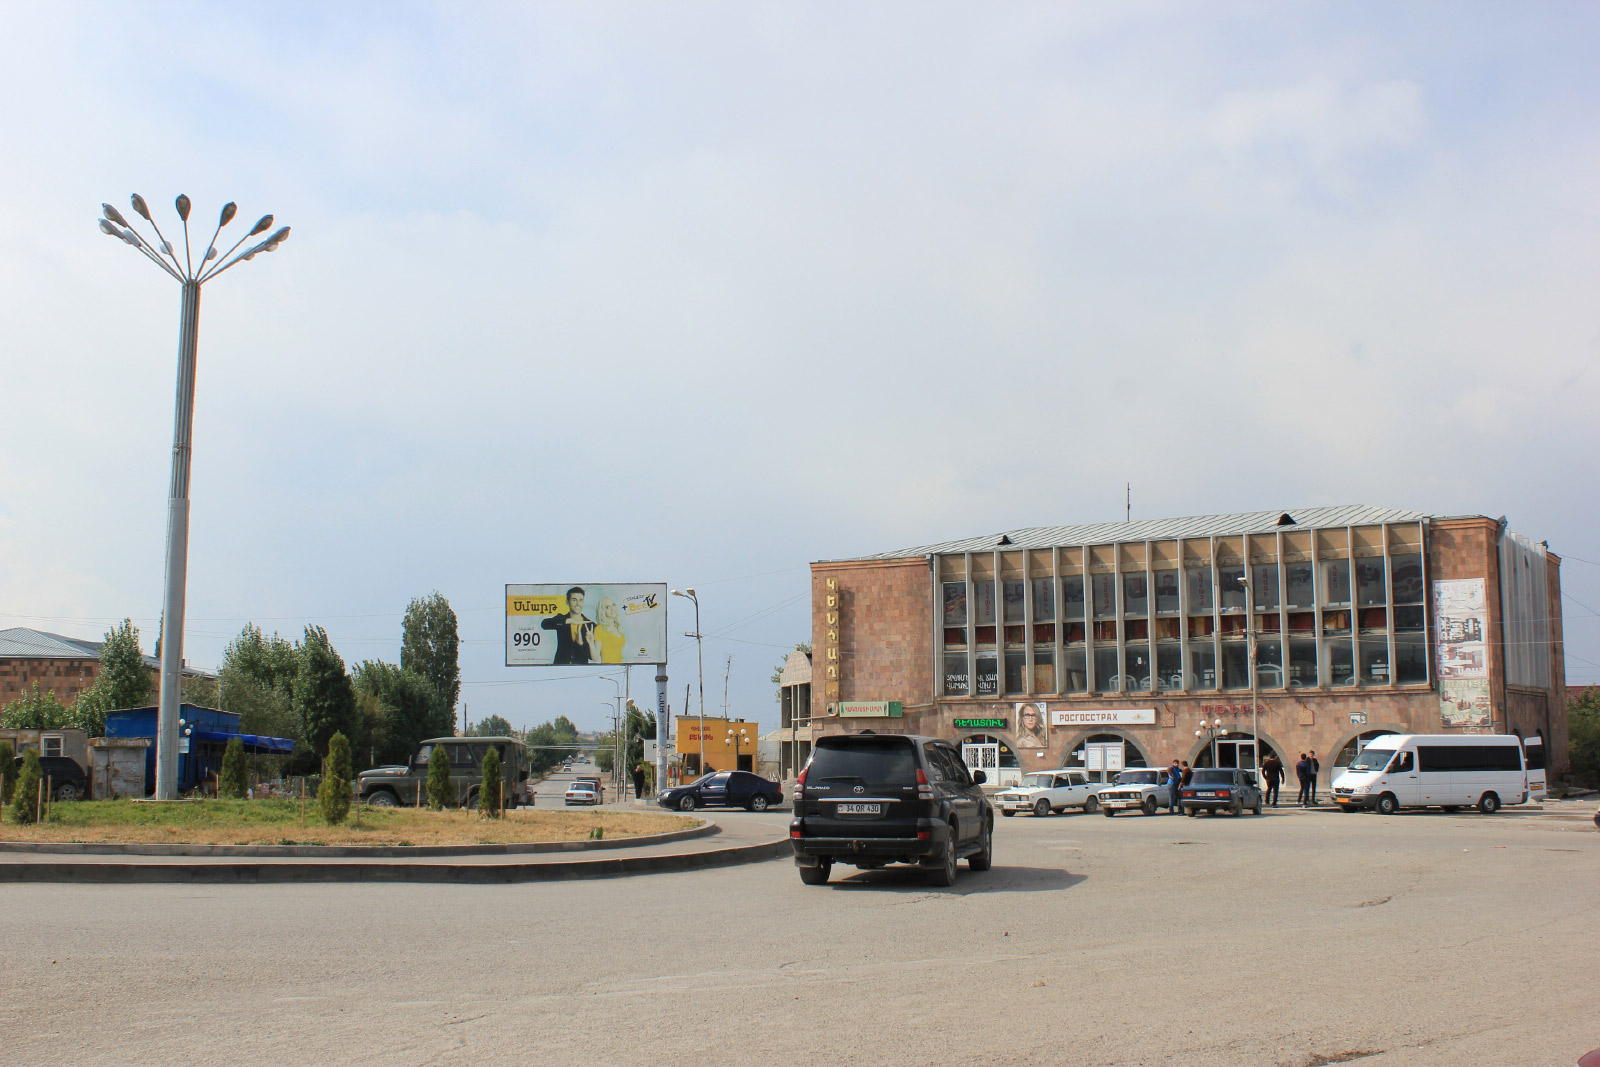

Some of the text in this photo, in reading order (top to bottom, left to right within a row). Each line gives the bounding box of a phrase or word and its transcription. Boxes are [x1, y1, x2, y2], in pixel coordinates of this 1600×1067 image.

[514, 601, 557, 613] Սմարթ
[513, 632, 540, 646] 990
[1059, 713, 1118, 722] РОСГОССТРАХ
[954, 719, 1004, 727] ԴԵՂԱՏՈՒՆ
[846, 804, 879, 812] 34 QR 430
